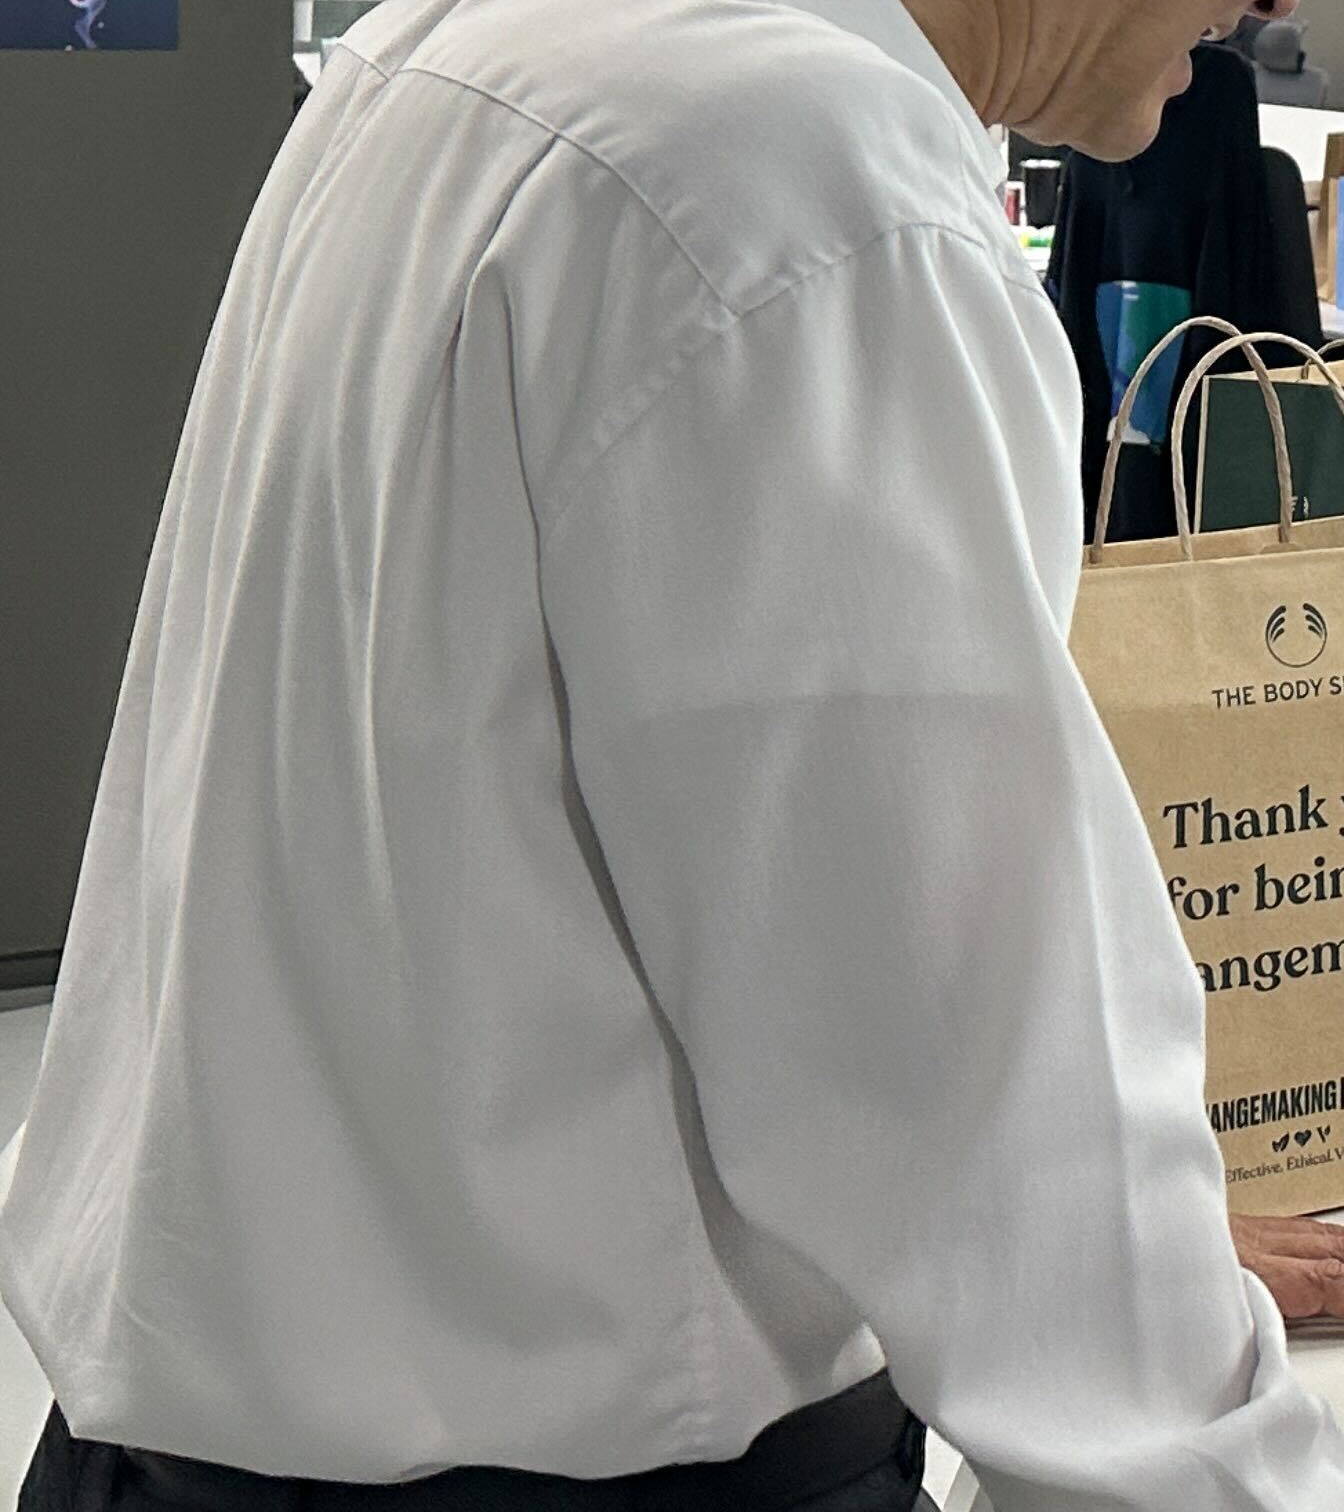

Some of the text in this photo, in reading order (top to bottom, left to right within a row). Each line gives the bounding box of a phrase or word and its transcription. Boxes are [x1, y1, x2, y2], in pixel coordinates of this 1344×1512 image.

[1211, 685, 1256, 709] THE
[1263, 677, 1324, 703] BODY
[1162, 784, 1328, 849] Thank
[1167, 876, 1240, 920] for
